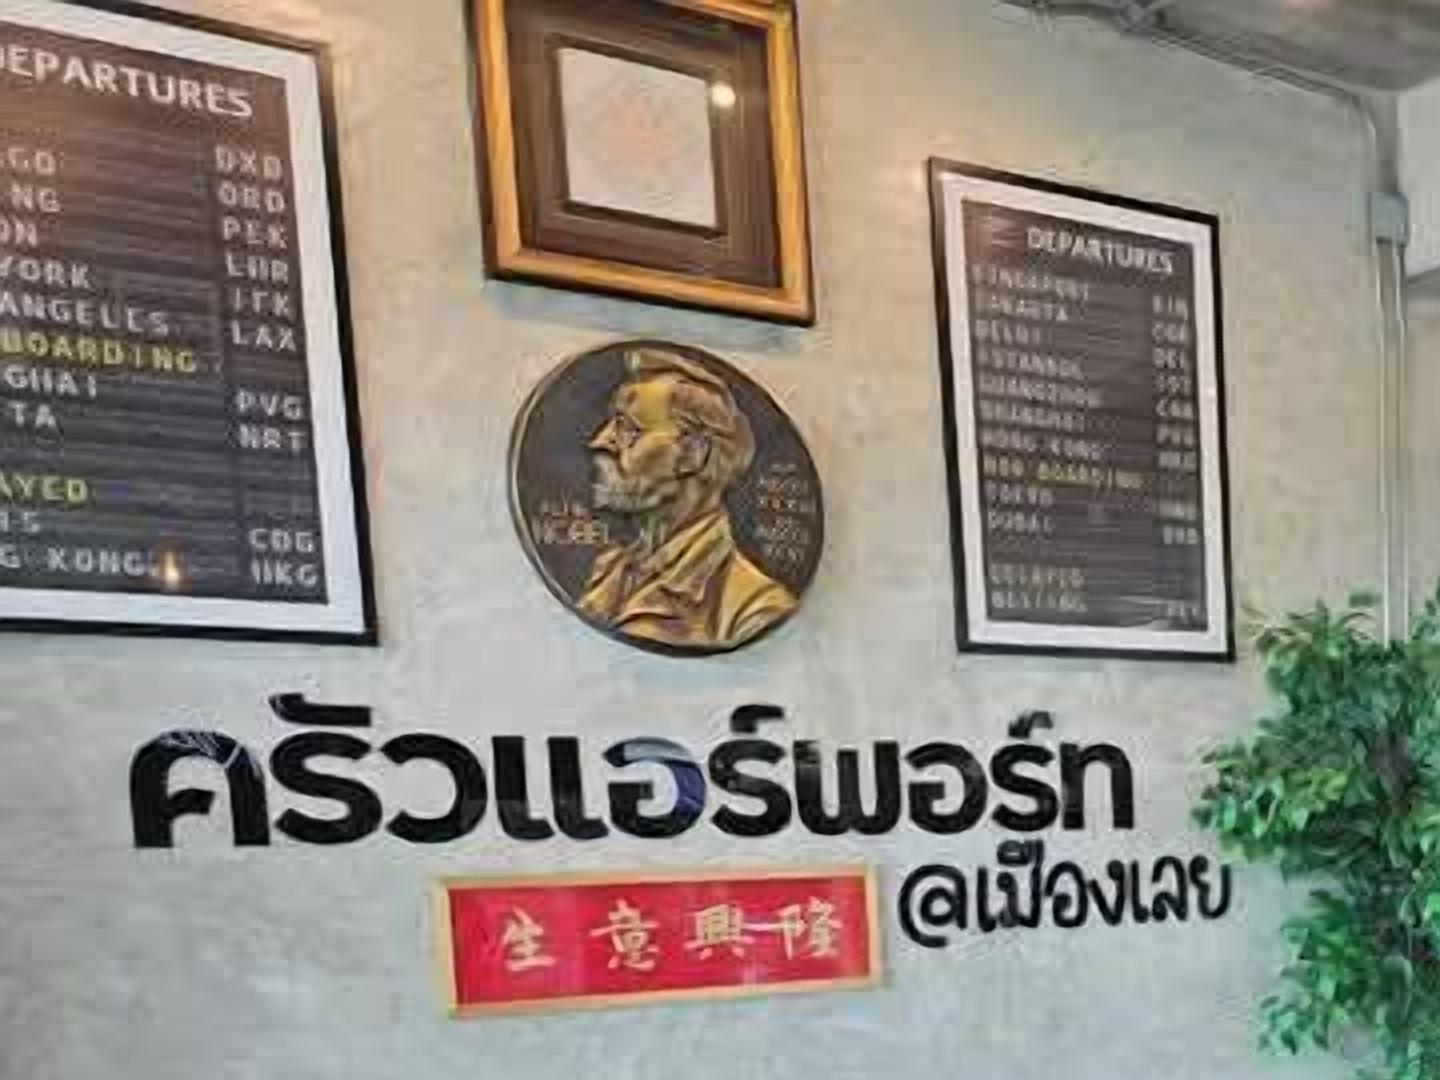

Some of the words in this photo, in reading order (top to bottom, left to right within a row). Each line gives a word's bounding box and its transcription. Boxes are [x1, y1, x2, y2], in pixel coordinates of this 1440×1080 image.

[0, 44, 253, 118] EPARTURES
[1027, 226, 1174, 275] DEPARTURES
[232, 320, 296, 351] LAX
[897, 839, 1232, 948] @เมืองเลย
